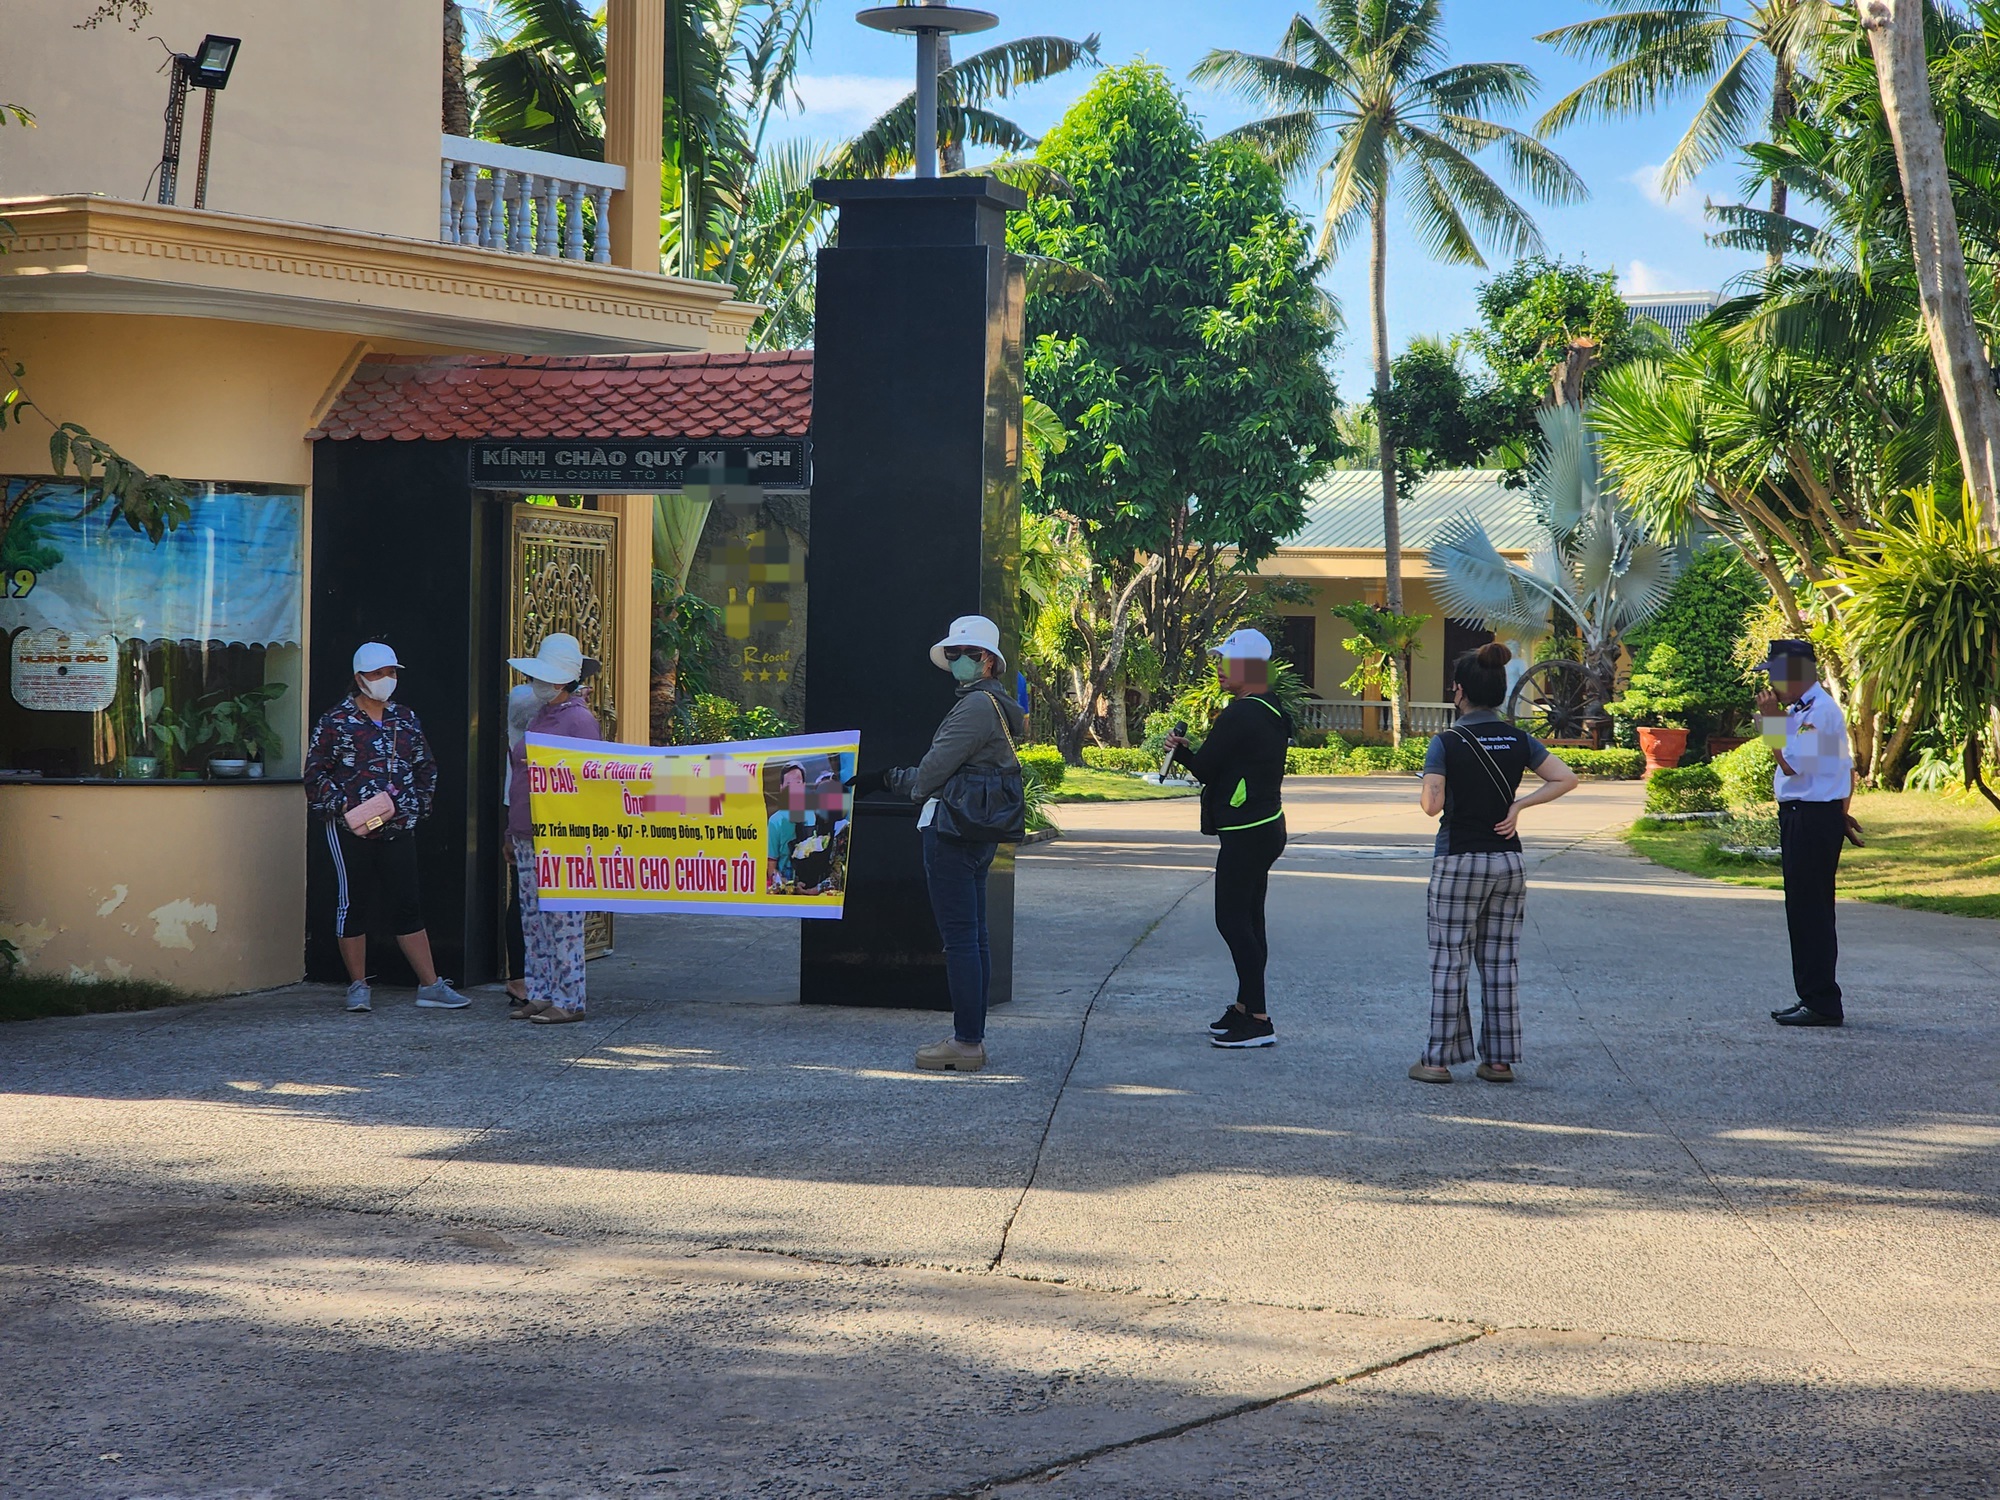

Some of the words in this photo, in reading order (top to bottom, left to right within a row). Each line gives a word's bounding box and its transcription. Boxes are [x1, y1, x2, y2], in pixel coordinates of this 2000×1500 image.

[482, 447, 545, 465] KÍNH
[555, 447, 627, 466] CHÀO
[635, 447, 688, 468] QUÝ
[520, 469, 622, 480] WELCOME
[630, 469, 657, 480] TO
[604, 761, 638, 784] Phạm
[592, 823, 609, 841] Đạo
[617, 824, 633, 840] Kp7
[641, 824, 649, 838] P.
[650, 824, 677, 841] Dương
[678, 824, 703, 841] Đông,
[704, 825, 715, 841] Tp
[717, 825, 734, 840] Phú
[735, 823, 758, 841] Quốc
[565, 845, 597, 888] TRẢ
[599, 846, 635, 889] TIỀN
[639, 857, 670, 891] CHO
[674, 851, 727, 892] CHÚNG
[731, 852, 755, 893] TÔI
